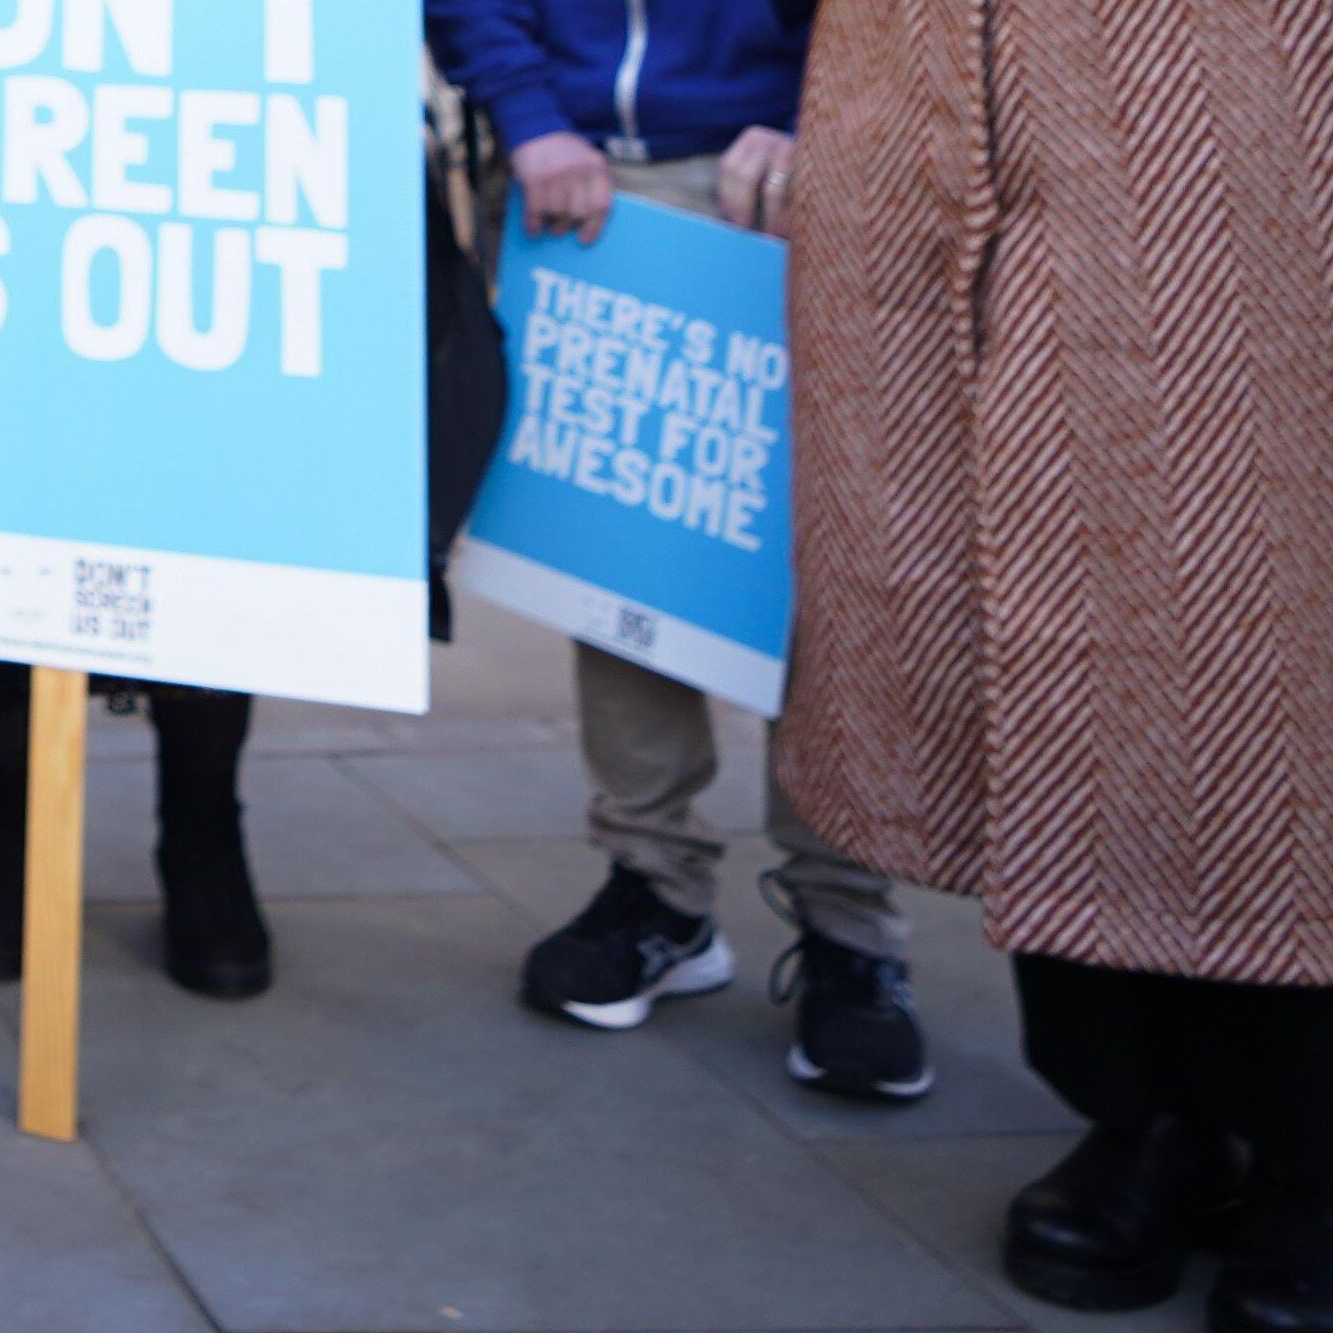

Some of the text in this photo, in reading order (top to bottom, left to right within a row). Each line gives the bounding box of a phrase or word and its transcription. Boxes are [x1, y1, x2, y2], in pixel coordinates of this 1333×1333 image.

[60, 213, 349, 379] OUT
[532, 267, 789, 390] THERE'S NO
[523, 312, 777, 445] PRENATAL
[523, 362, 770, 493] TEST FOR
[509, 414, 767, 553] AWESOME
